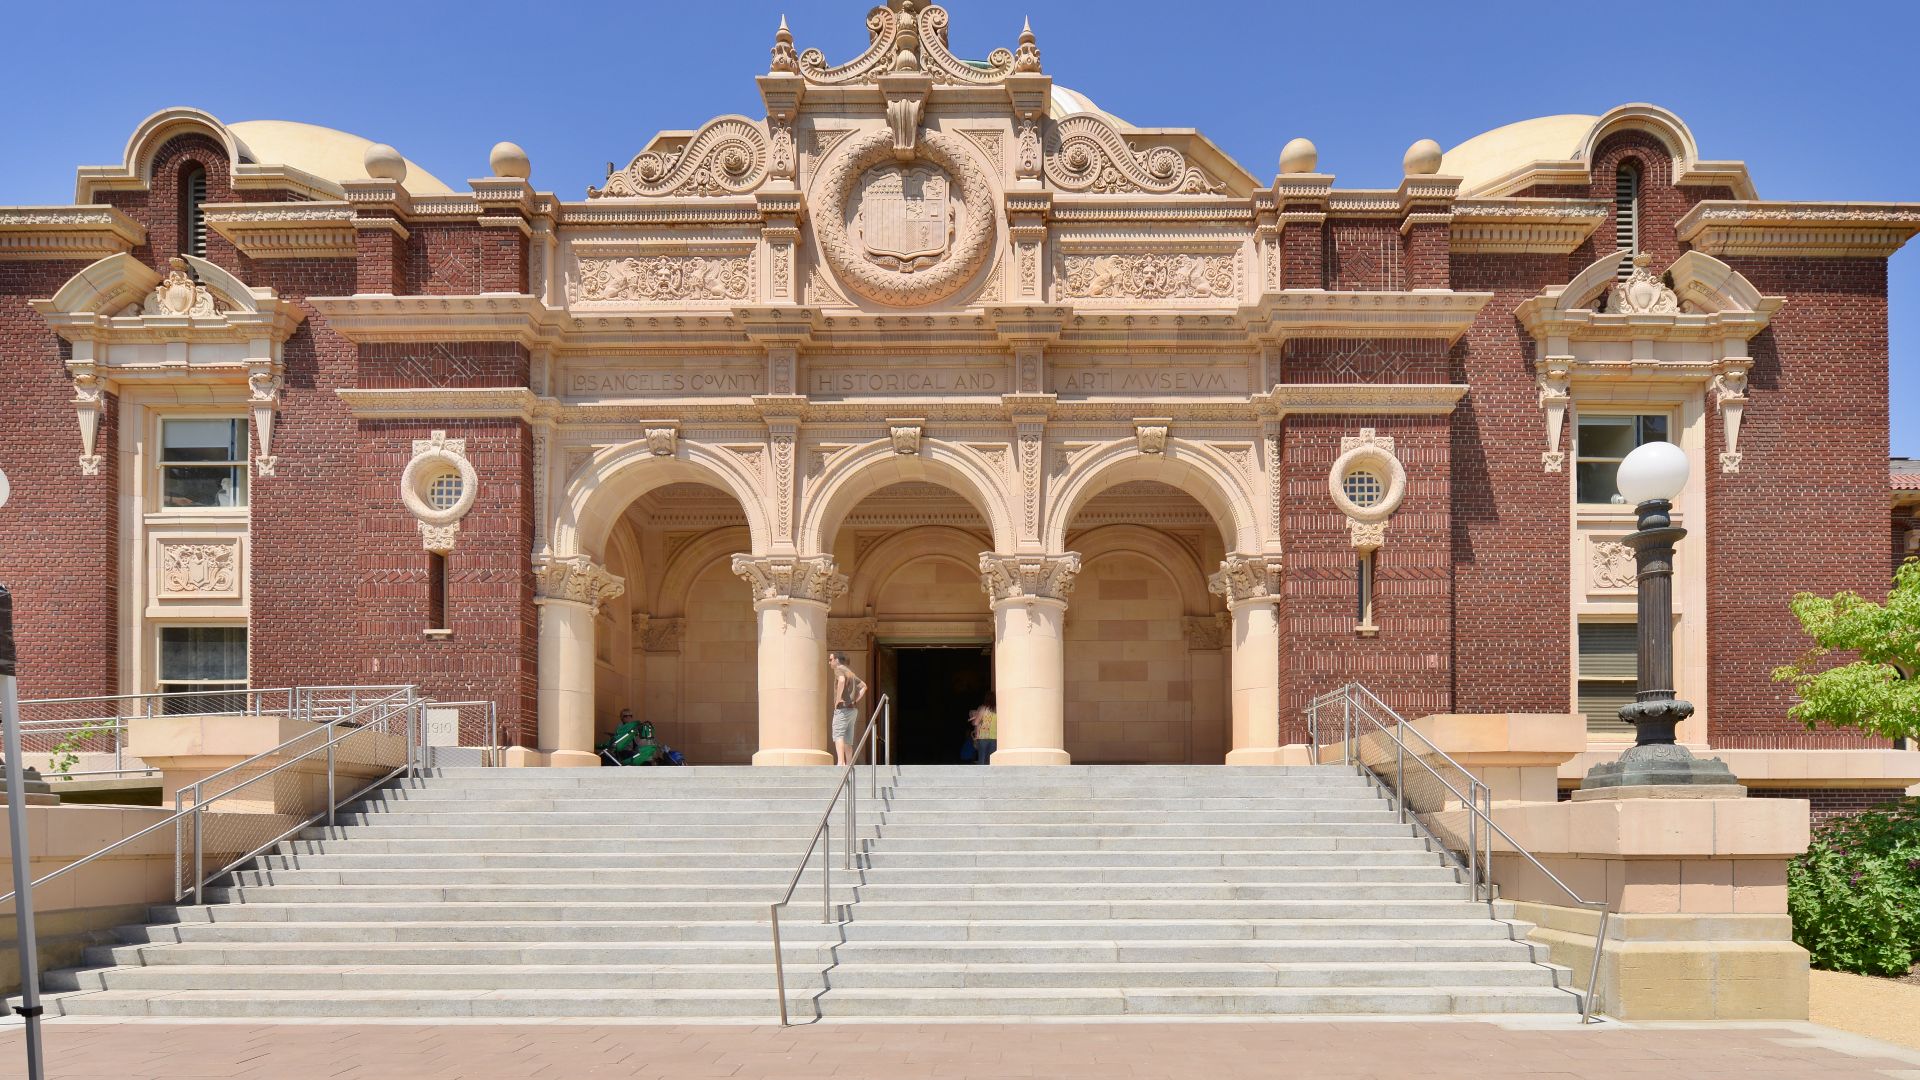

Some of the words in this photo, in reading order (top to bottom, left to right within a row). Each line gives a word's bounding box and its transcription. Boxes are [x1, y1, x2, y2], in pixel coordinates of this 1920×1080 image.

[819, 374, 945, 391] HISTORICAL
[954, 374, 996, 390] AND
[1065, 372, 1110, 389] ART
